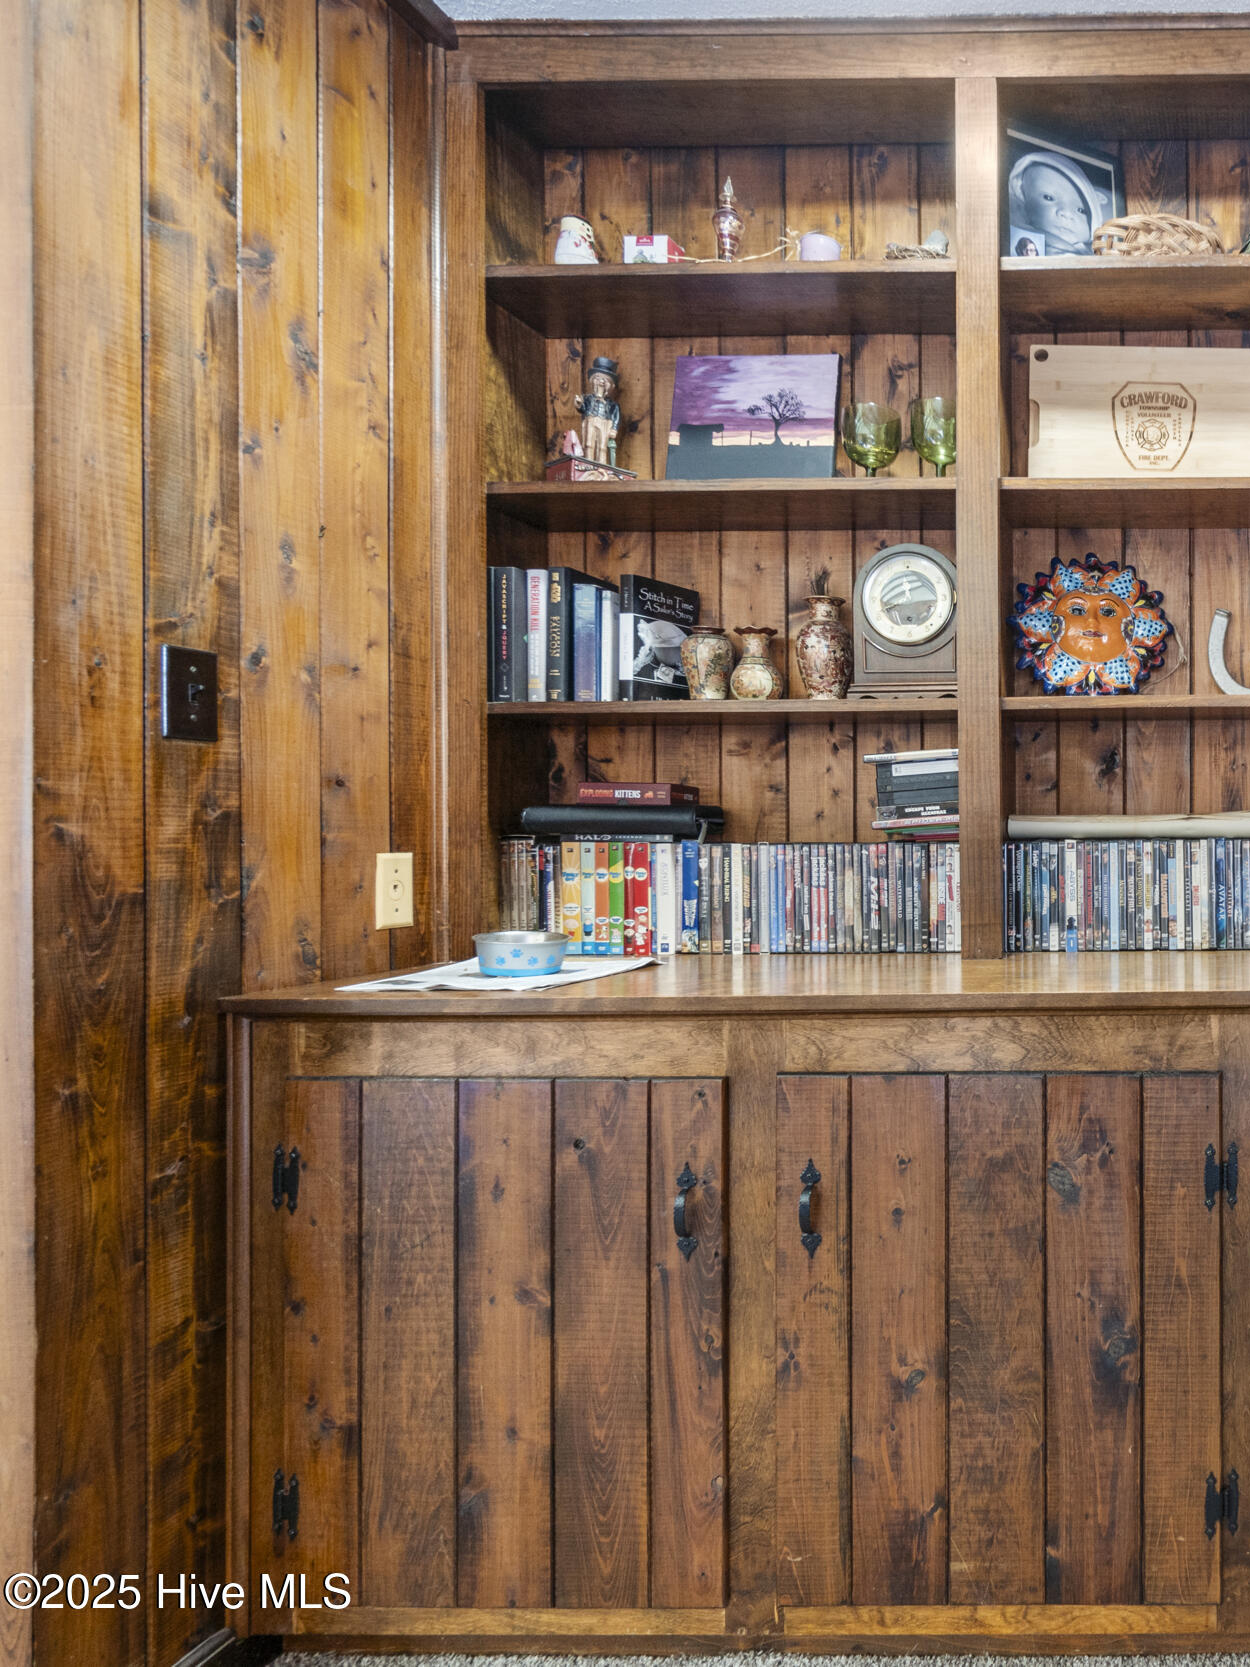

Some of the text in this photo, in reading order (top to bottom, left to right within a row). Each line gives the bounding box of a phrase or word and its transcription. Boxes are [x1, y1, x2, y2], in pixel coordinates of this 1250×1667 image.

[1120, 392, 1188, 409] CRAWFORD
[530, 576, 540, 615] GENERATION
[639, 587, 694, 611] Stitch in Time
[644, 601, 652, 612] A
[675, 610, 693, 622] Story
[530, 618, 539, 631] KILL
[614, 790, 641, 799] KITTENS
